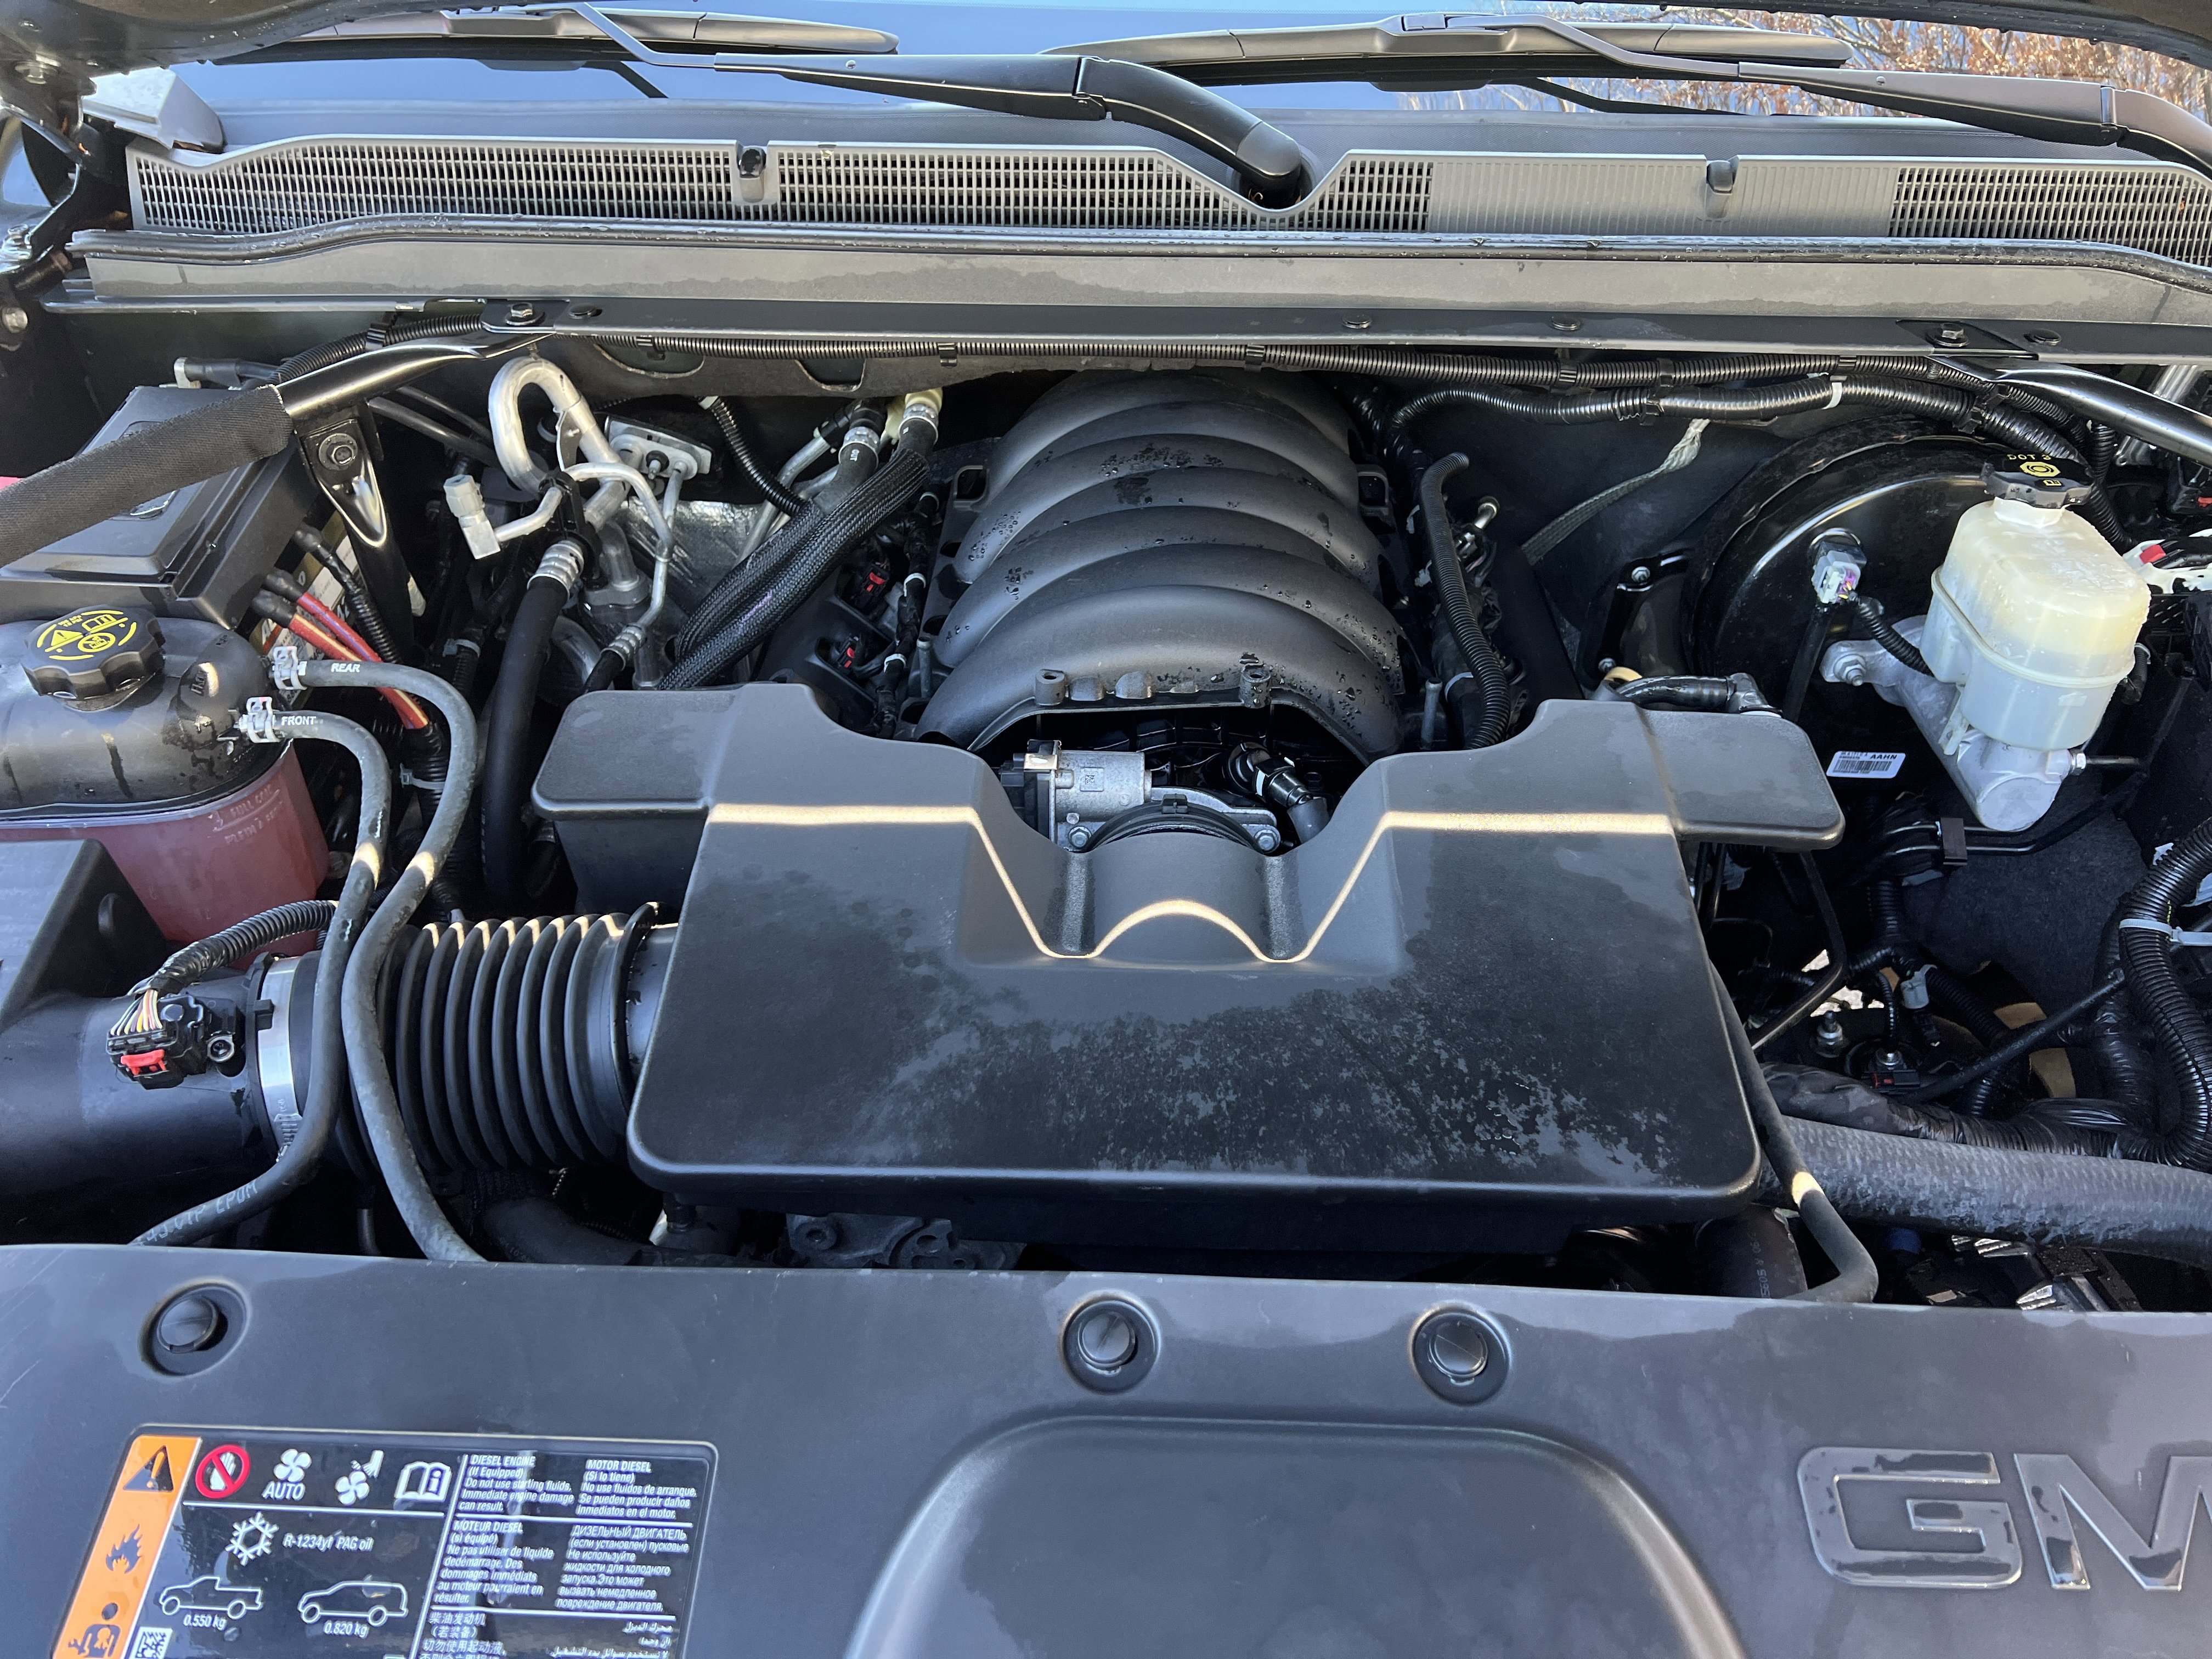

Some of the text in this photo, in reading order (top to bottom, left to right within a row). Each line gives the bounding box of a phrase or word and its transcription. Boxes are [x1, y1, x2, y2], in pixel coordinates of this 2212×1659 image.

[331, 663, 360, 673] REAR
[281, 715, 317, 726] FRONT
[470, 1455, 536, 1467] DIESEL ENGINE
[586, 1459, 652, 1473] MOTOR DIESEL
[468, 1466, 524, 1479] (If Equipped)
[584, 1471, 636, 1483] (Si lo tiene)
[262, 1481, 306, 1500] AUTO
[465, 1479, 477, 1487] Do
[479, 1480, 494, 1488] not
[513, 1480, 544, 1491] starting
[546, 1480, 571, 1491] fluids.
[581, 1482, 697, 1498] No use fluidos de arranque.
[461, 1489, 575, 1505] Immediate engine damage
[578, 1493, 691, 1509] Se pueden producir daños
[477, 1501, 504, 1511] result.
[575, 1505, 676, 1520] inmediatos en el motor.
[453, 1520, 523, 1533] MOTEUR DIESEL
[571, 1525, 687, 1541] ДИЗЕЛЬНЫЙ ДВИГАТЕЛЬ
[283, 1533, 374, 1552] R-1234yf PAG oil
[450, 1532, 499, 1544] (si équipé)
[447, 1544, 555, 1561] Ne pas utiliser de liquide
[569, 1538, 690, 1554] (если установлен) пусковые
[566, 1549, 637, 1563] Не используйте
[505, 1558, 523, 1570] Des
[563, 1562, 672, 1576] жидкости для холодного
[440, 1567, 538, 1583] dommages immédiats
[616, 1576, 645, 1587] может
[437, 1581, 544, 1595] au moteur pourraient en
[557, 1585, 657, 1600] вызвать немедленное
[433, 1593, 470, 1604] résulter.
[616, 1600, 664, 1612] двигателя.
[183, 1614, 227, 1630] 0.550 kg
[430, 1612, 486, 1626] 柴油发动机
[324, 1621, 369, 1638] 0.820 kg
